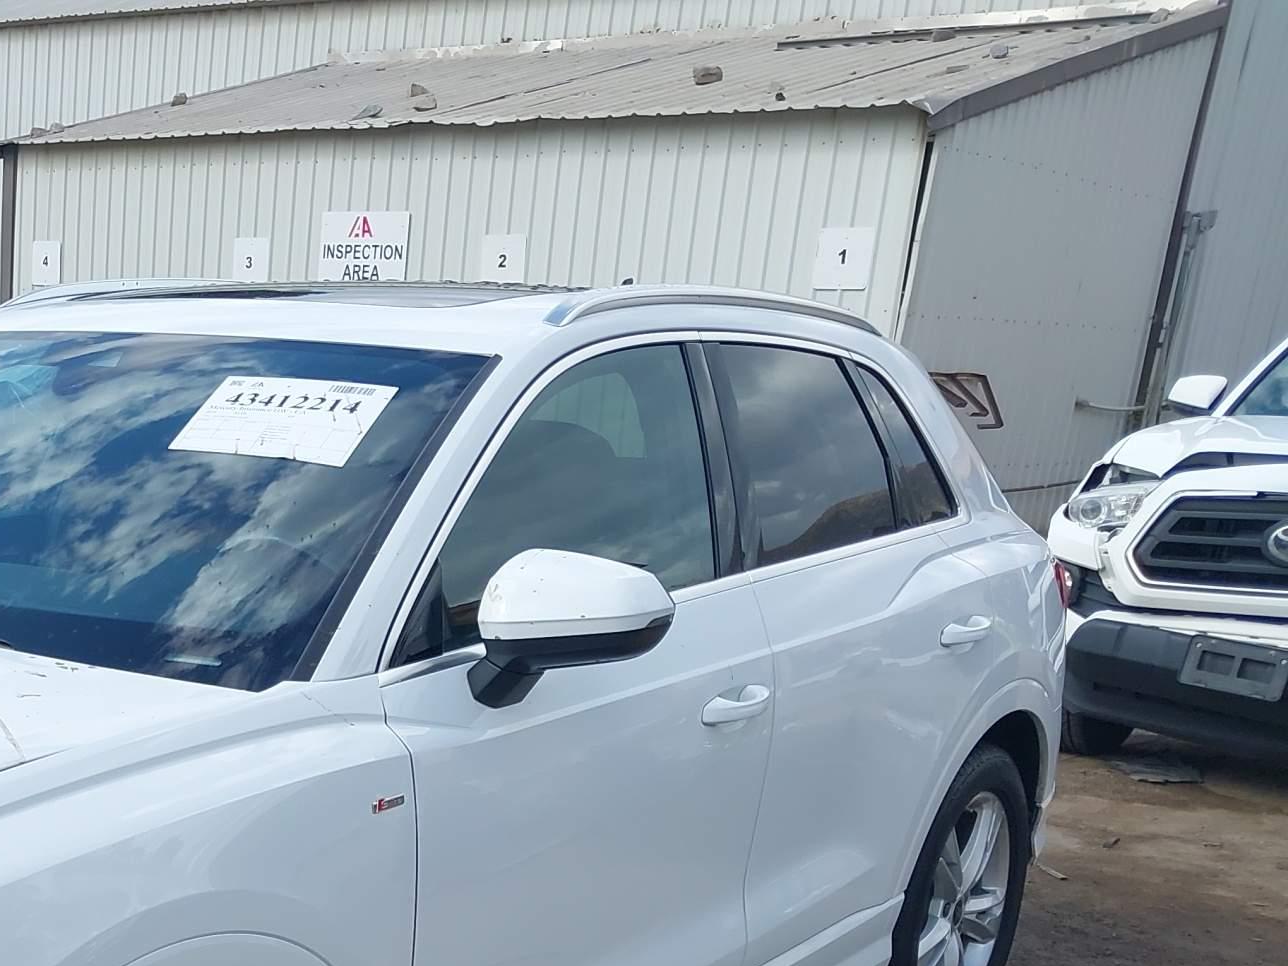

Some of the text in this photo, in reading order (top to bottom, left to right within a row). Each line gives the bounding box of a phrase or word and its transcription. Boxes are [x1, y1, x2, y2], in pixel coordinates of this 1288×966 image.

[323, 244, 403, 260] INSPECTION
[838, 248, 847, 265] 1
[42, 255, 49, 267] 4
[245, 256, 253, 269] 3
[498, 254, 507, 268] 2
[342, 264, 380, 281] AREA
[225, 392, 362, 414] 43412214
